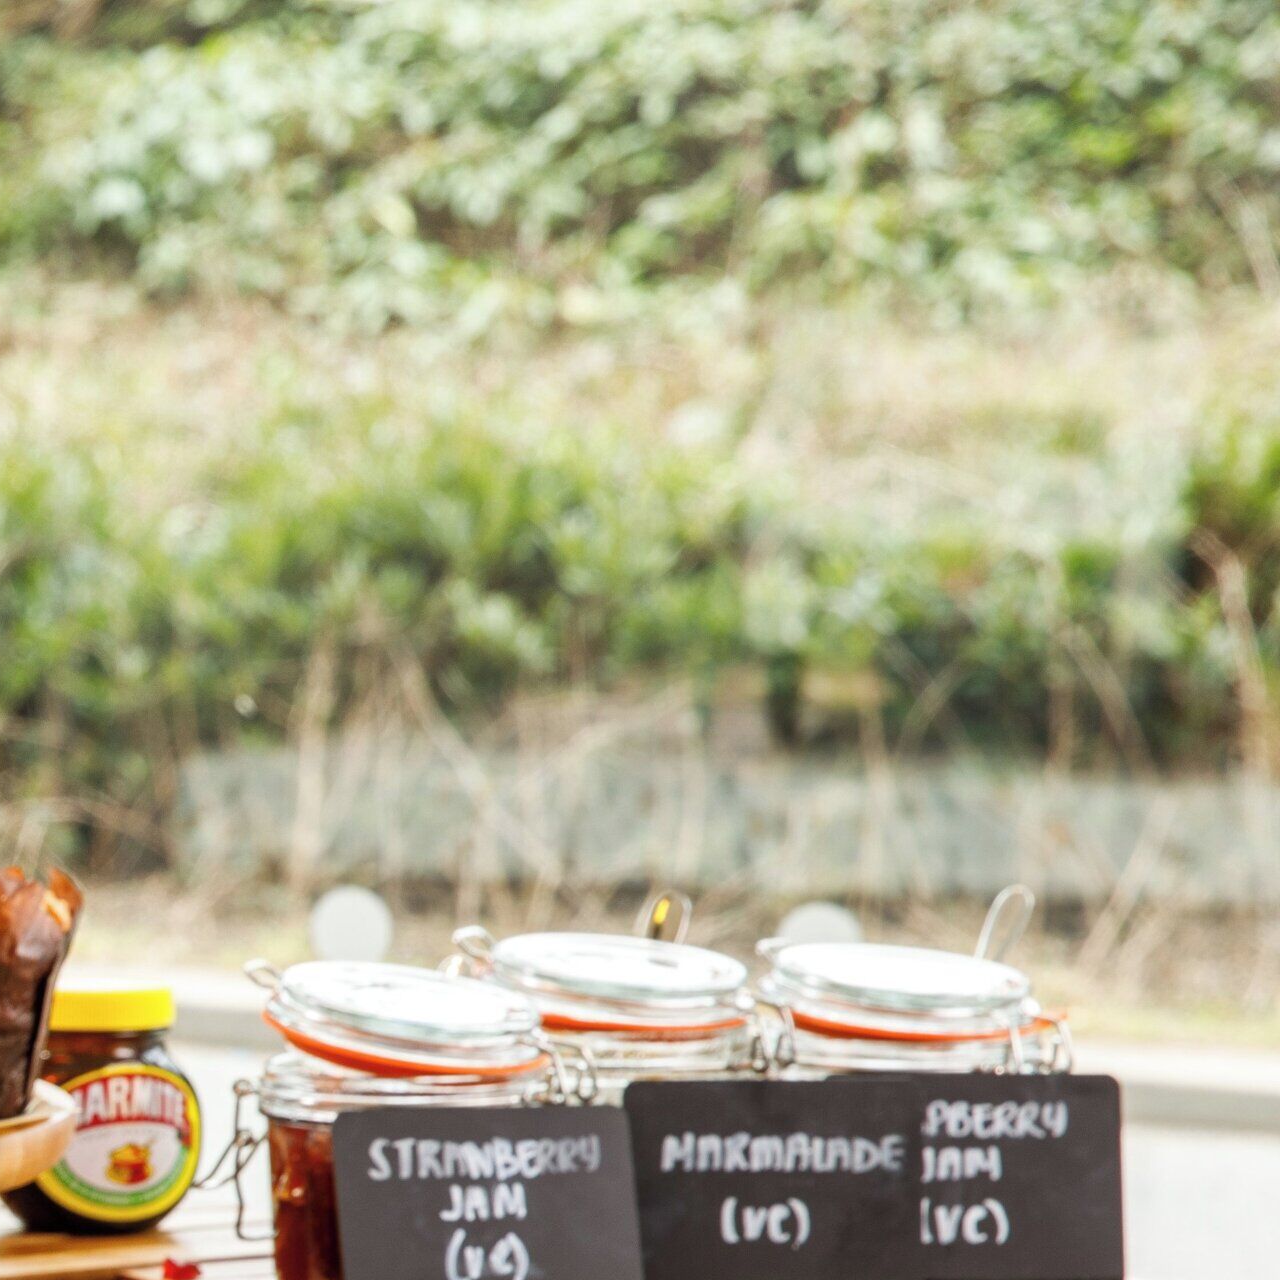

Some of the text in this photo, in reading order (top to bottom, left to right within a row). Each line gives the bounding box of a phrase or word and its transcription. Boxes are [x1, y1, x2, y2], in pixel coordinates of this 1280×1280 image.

[921, 1099, 1069, 1140] PBERRY
[660, 1132, 906, 1174] MARMALADE
[439, 1182, 527, 1222] JAM
